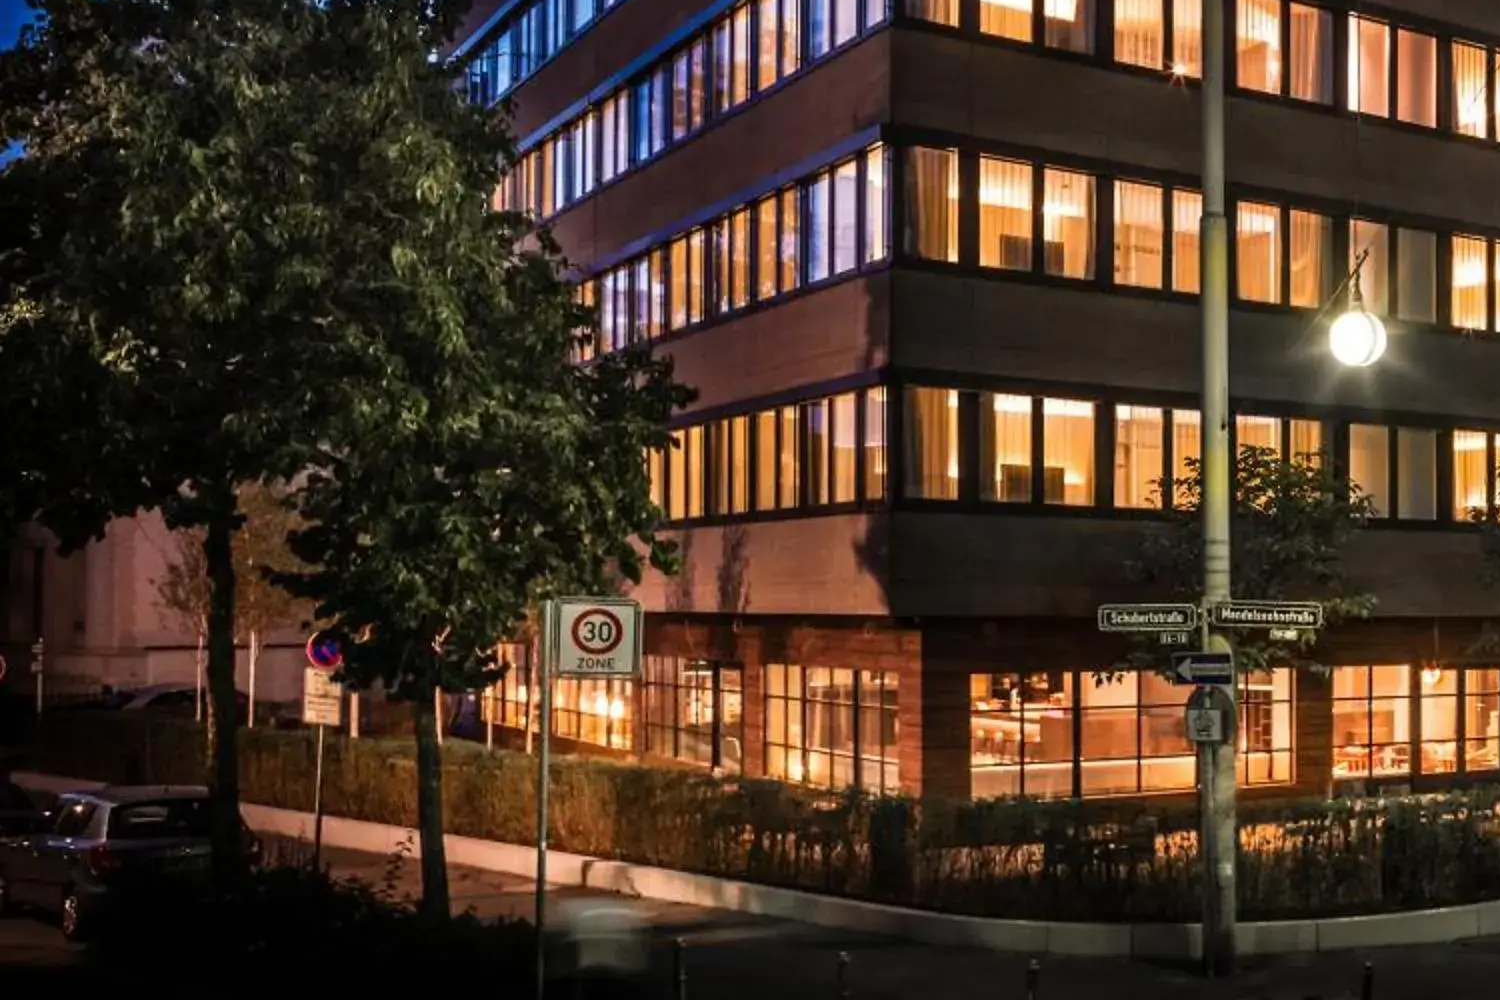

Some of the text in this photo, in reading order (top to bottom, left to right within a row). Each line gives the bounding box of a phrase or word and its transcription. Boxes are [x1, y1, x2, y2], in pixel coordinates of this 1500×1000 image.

[1111, 611, 1185, 624] Schubertstraße
[583, 621, 613, 643] 30
[576, 657, 616, 670] ZONE
